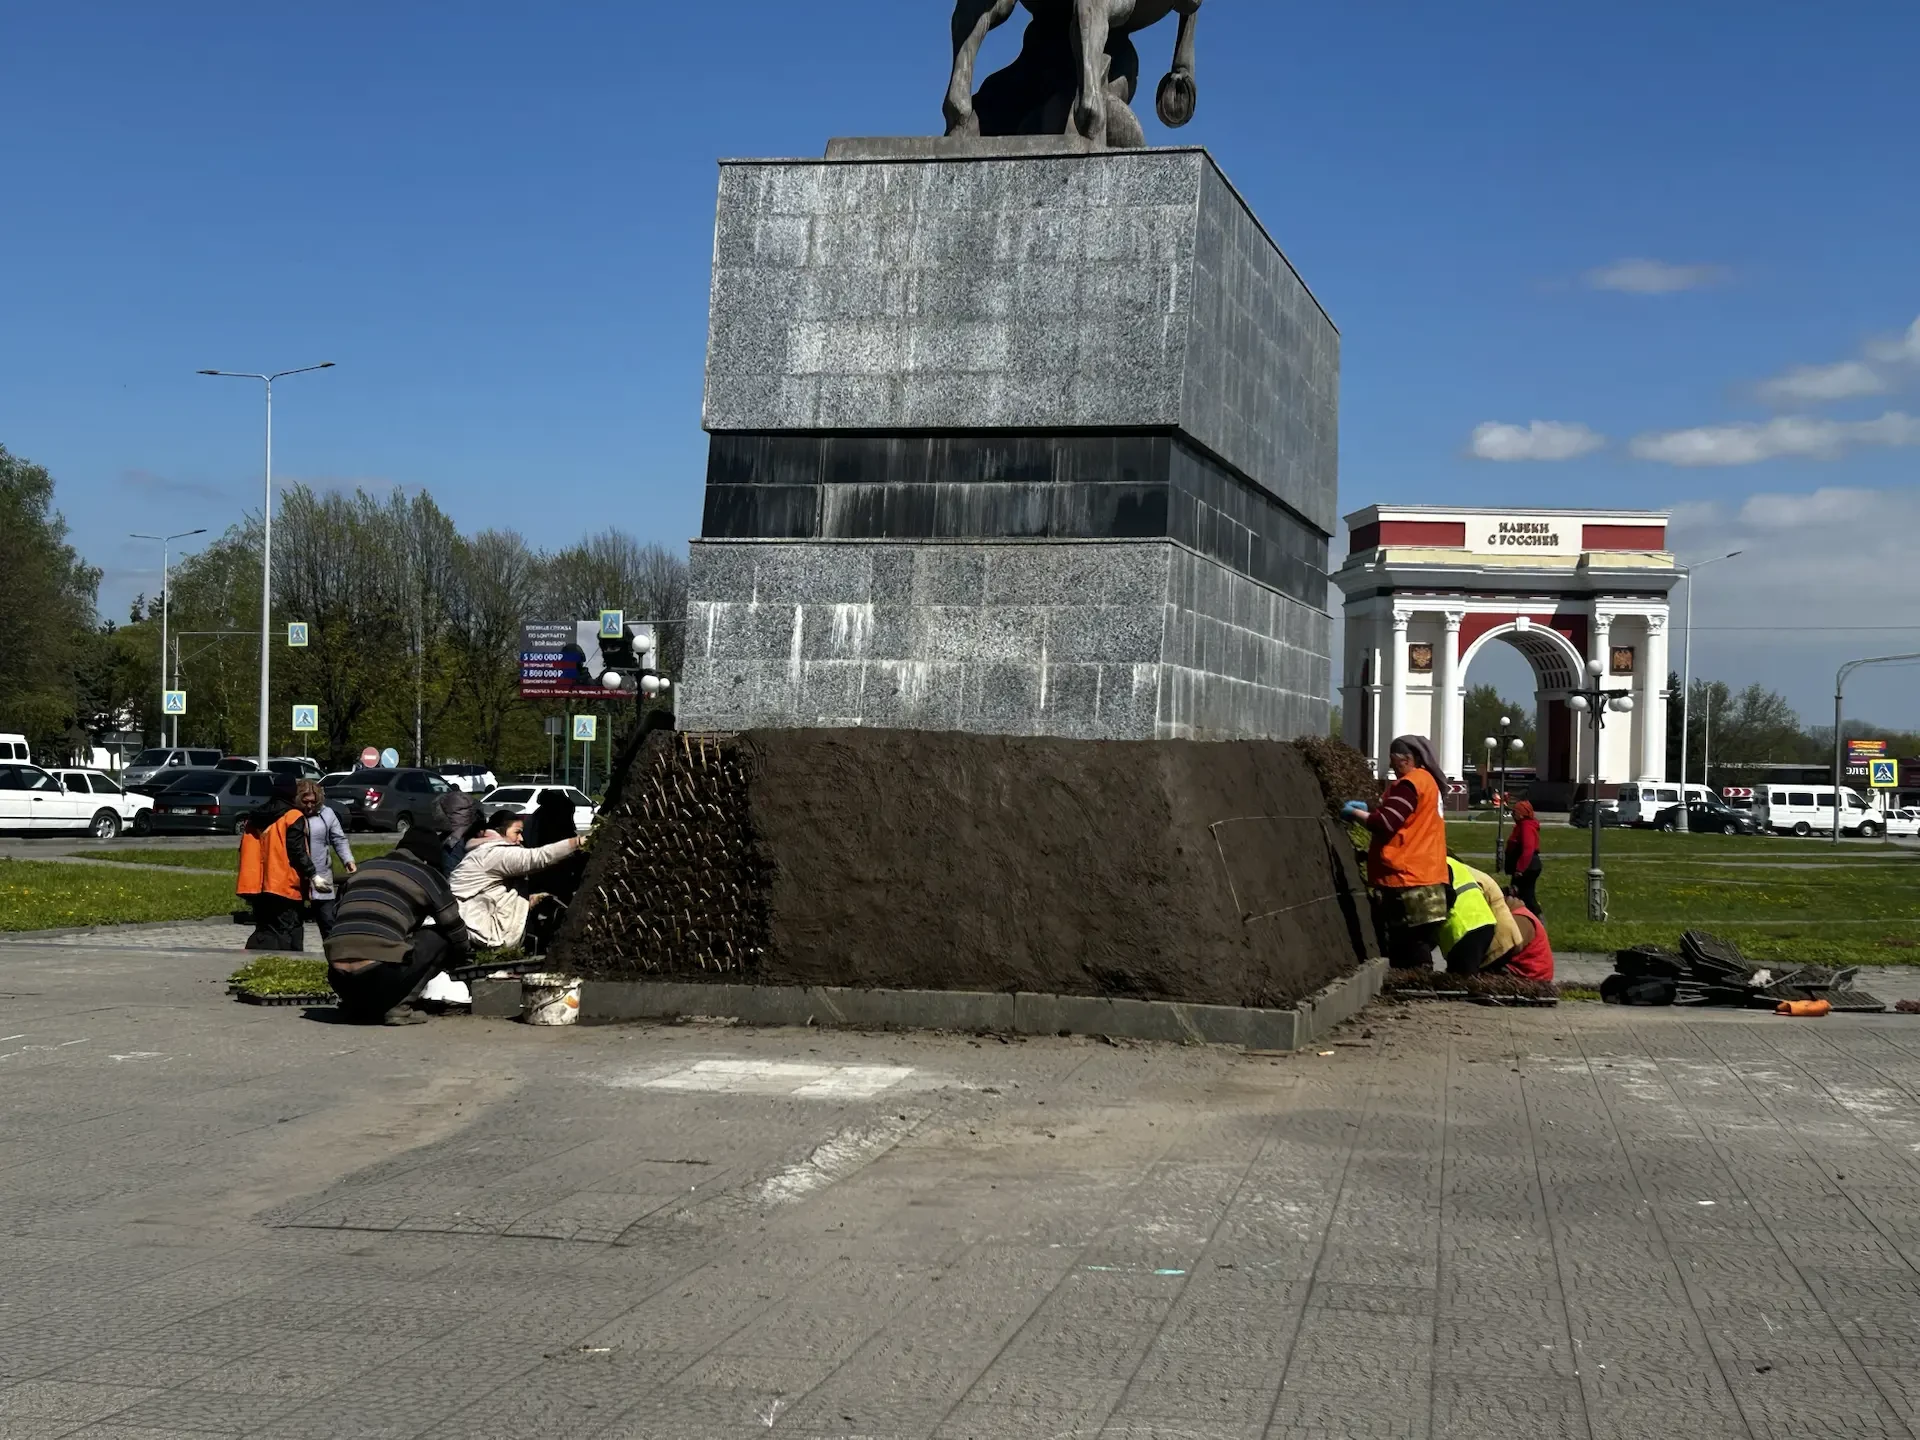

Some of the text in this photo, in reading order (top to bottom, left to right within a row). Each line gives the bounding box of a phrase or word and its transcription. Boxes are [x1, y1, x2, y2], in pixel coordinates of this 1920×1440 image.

[1498, 522, 1550, 534] НАВЕКИ
[1487, 533, 1559, 546] С РОССИЕЙ
